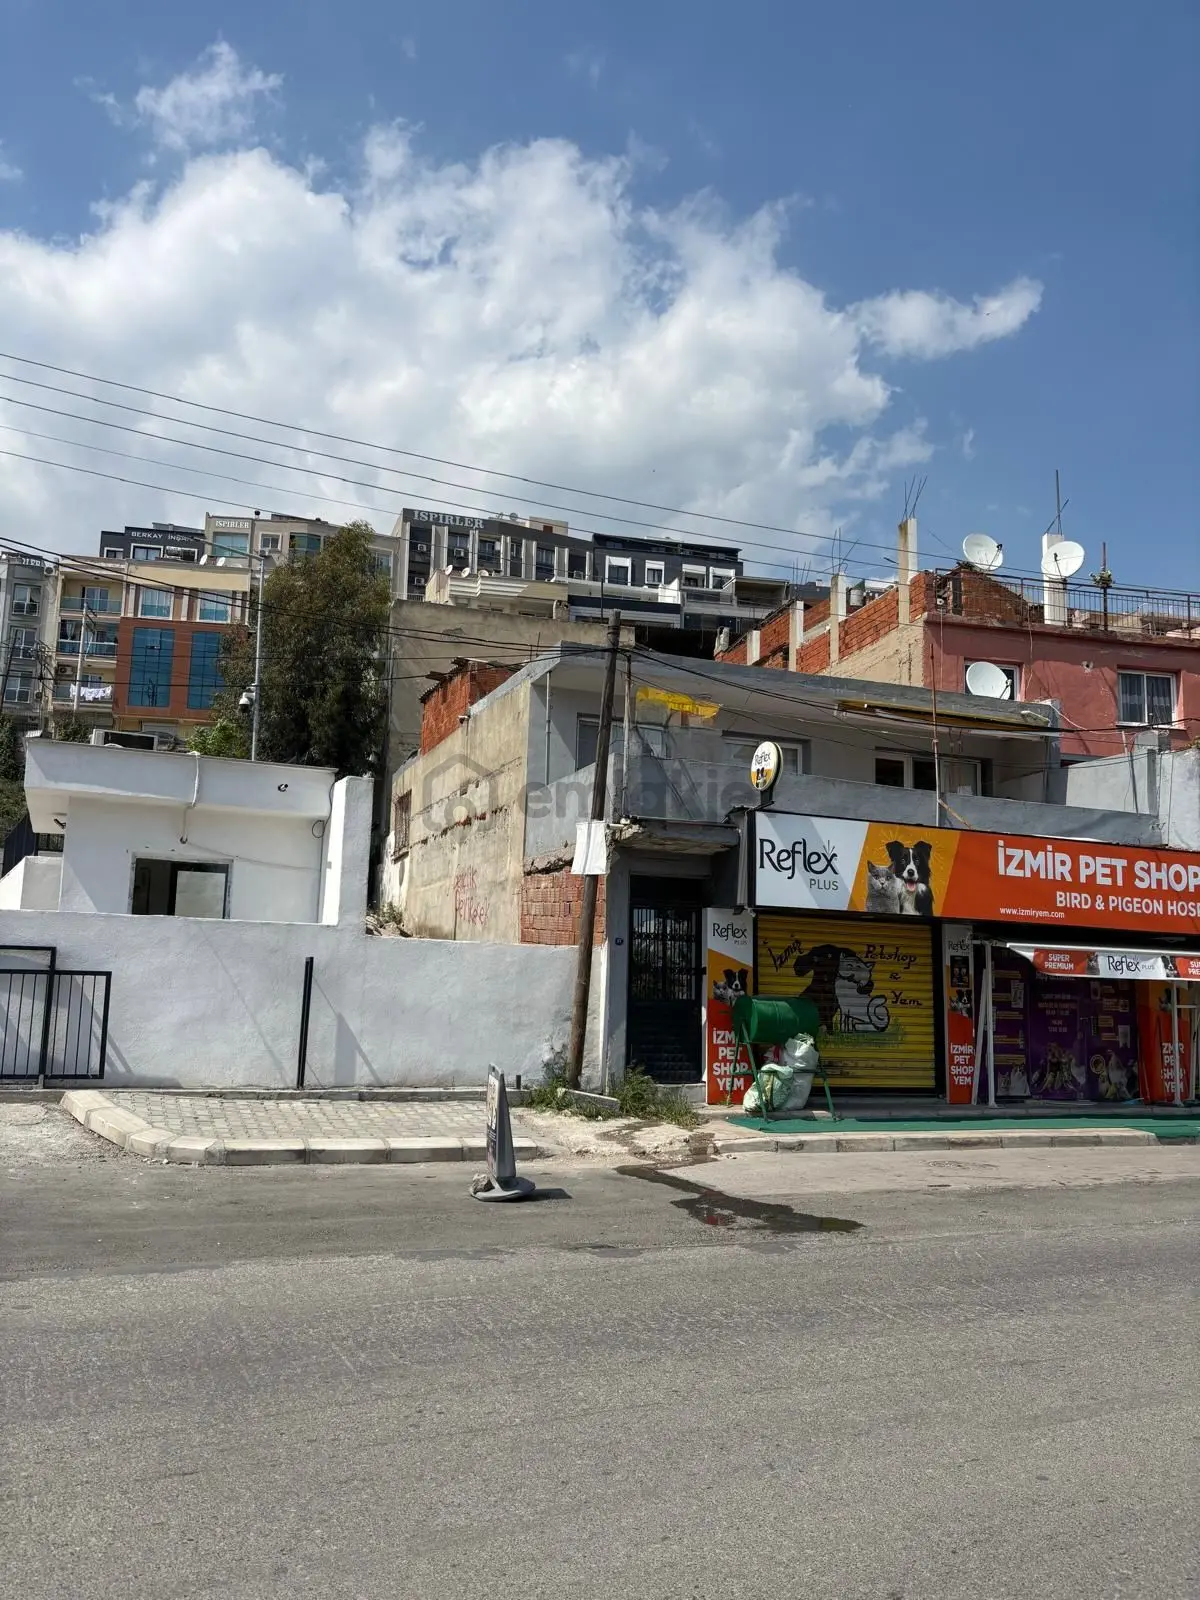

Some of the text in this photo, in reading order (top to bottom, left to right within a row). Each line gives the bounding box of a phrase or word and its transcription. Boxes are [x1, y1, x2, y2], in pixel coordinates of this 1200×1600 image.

[131, 531, 163, 539] BERKAY
[759, 837, 839, 880] Reflex
[997, 839, 1200, 893] İZMİR PET SHOP
[809, 878, 839, 891] PLUS
[1056, 890, 1092, 910] BIRD
[1095, 894, 1105, 911] &
[1108, 896, 1164, 915] PIGEON
[999, 907, 1065, 919] www.izmiryem.com
[712, 922, 748, 941] Reflex
[1048, 953, 1070, 962] SUPER
[1044, 961, 1074, 970] PREMIUM
[1107, 955, 1141, 975] Reflex
[712, 1027, 741, 1045] İZM
[954, 1055, 970, 1064] PET
[712, 1062, 749, 1076] SHOP
[950, 1065, 974, 1075] SHOP
[953, 1076, 972, 1085] YEM
